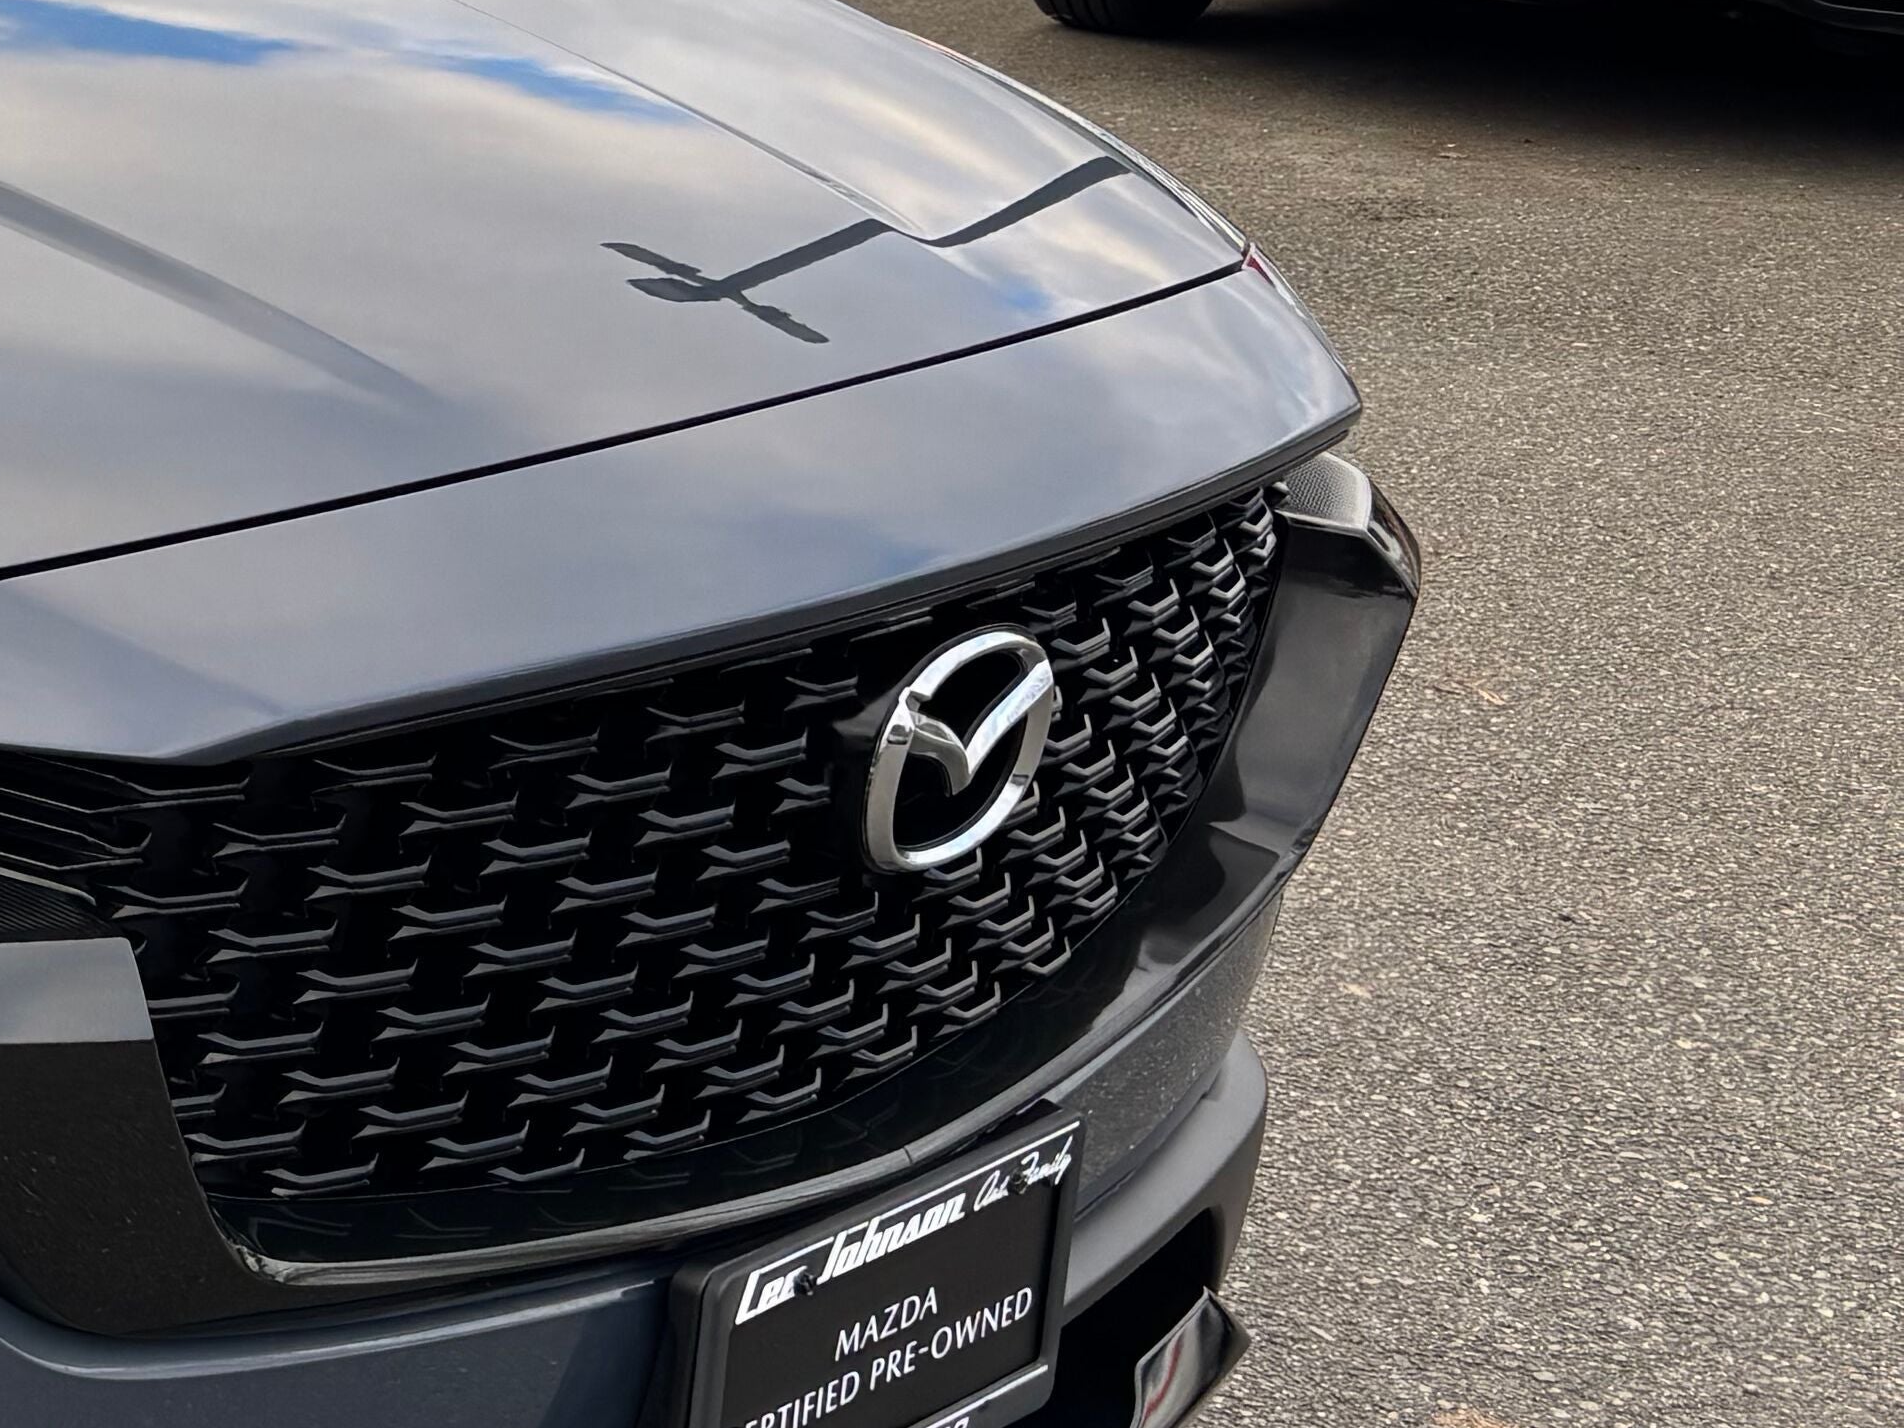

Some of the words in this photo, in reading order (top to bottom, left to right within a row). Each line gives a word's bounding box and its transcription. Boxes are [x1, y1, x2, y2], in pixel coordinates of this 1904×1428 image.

[816, 1192, 966, 1285] Johnson
[973, 1169, 1010, 1212] Aut
[835, 1286, 938, 1362] MAZDA
[869, 1286, 1033, 1391] PRE-OWNED
